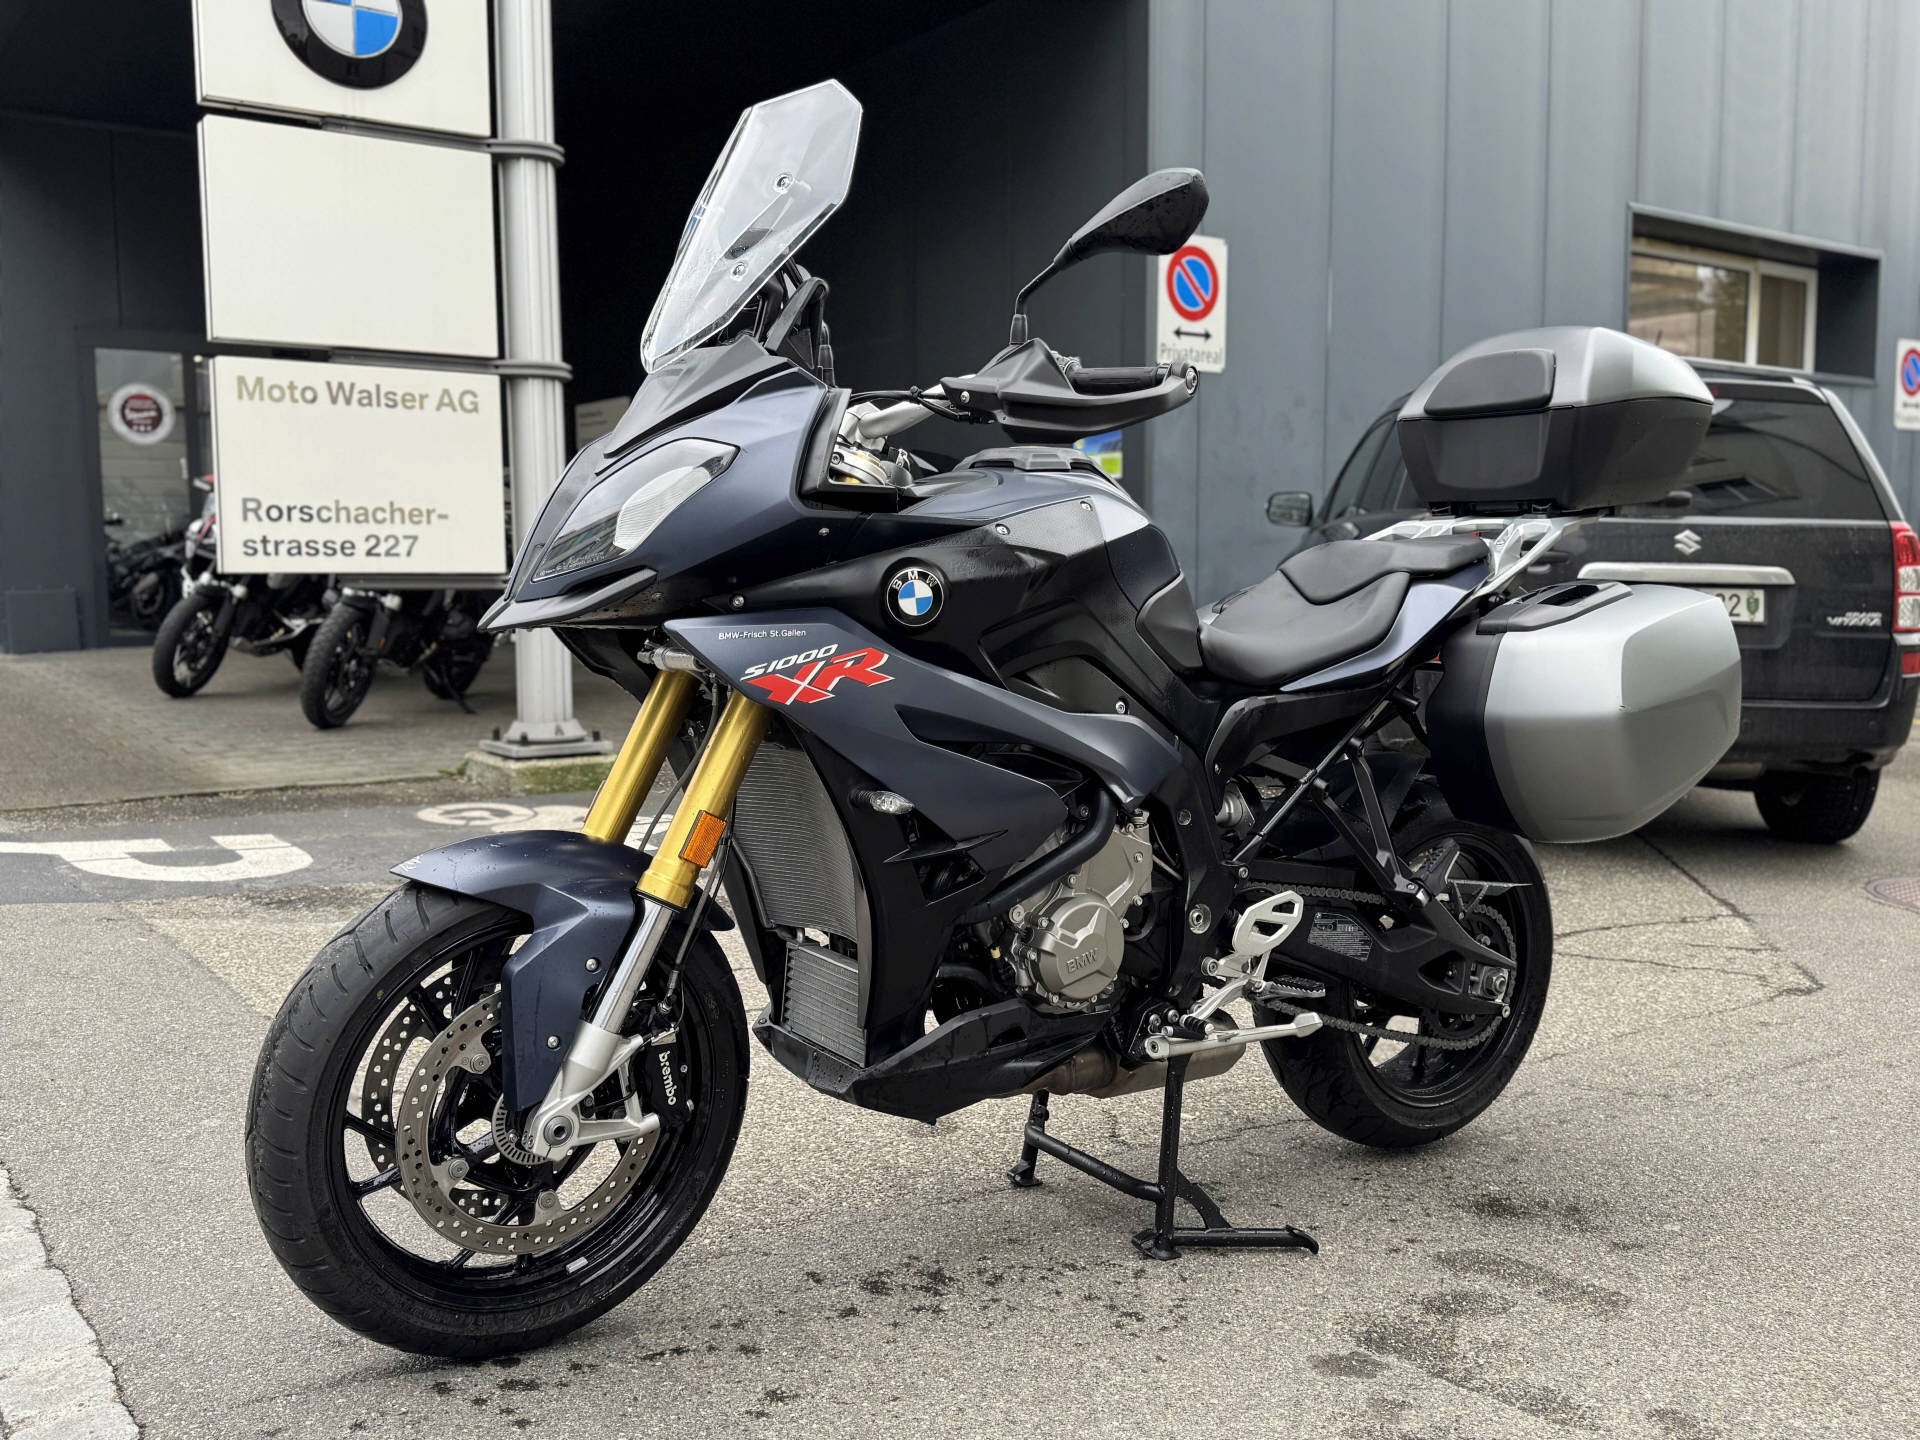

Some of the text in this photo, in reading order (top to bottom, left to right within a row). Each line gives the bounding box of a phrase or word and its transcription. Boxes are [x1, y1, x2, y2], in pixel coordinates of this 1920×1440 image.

[236, 376, 480, 414] Moto Walser AG
[241, 498, 449, 525] Rorschacher-
[242, 534, 419, 558] strasse 227
[892, 570, 937, 590] BMW
[718, 629, 806, 640] BMW-Frisch St.Gallen
[740, 643, 839, 681] S1000
[746, 647, 896, 706] XR
[1066, 948, 1097, 973] BMW
[658, 1050, 677, 1106] brembo
